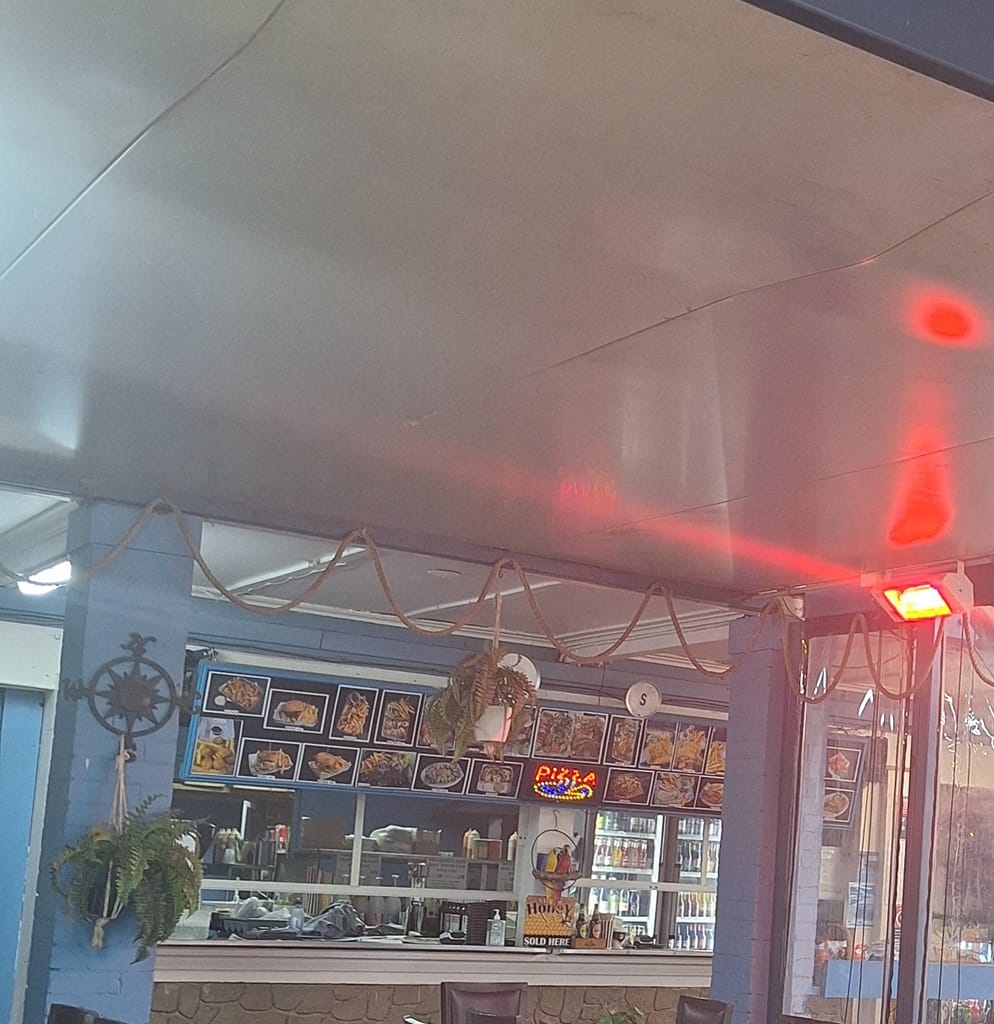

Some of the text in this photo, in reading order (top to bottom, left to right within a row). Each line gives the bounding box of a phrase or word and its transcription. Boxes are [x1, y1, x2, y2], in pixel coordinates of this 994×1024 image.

[640, 693, 647, 705] S
[527, 901, 570, 918] Honey
[524, 936, 570, 946] SOLD HERE
